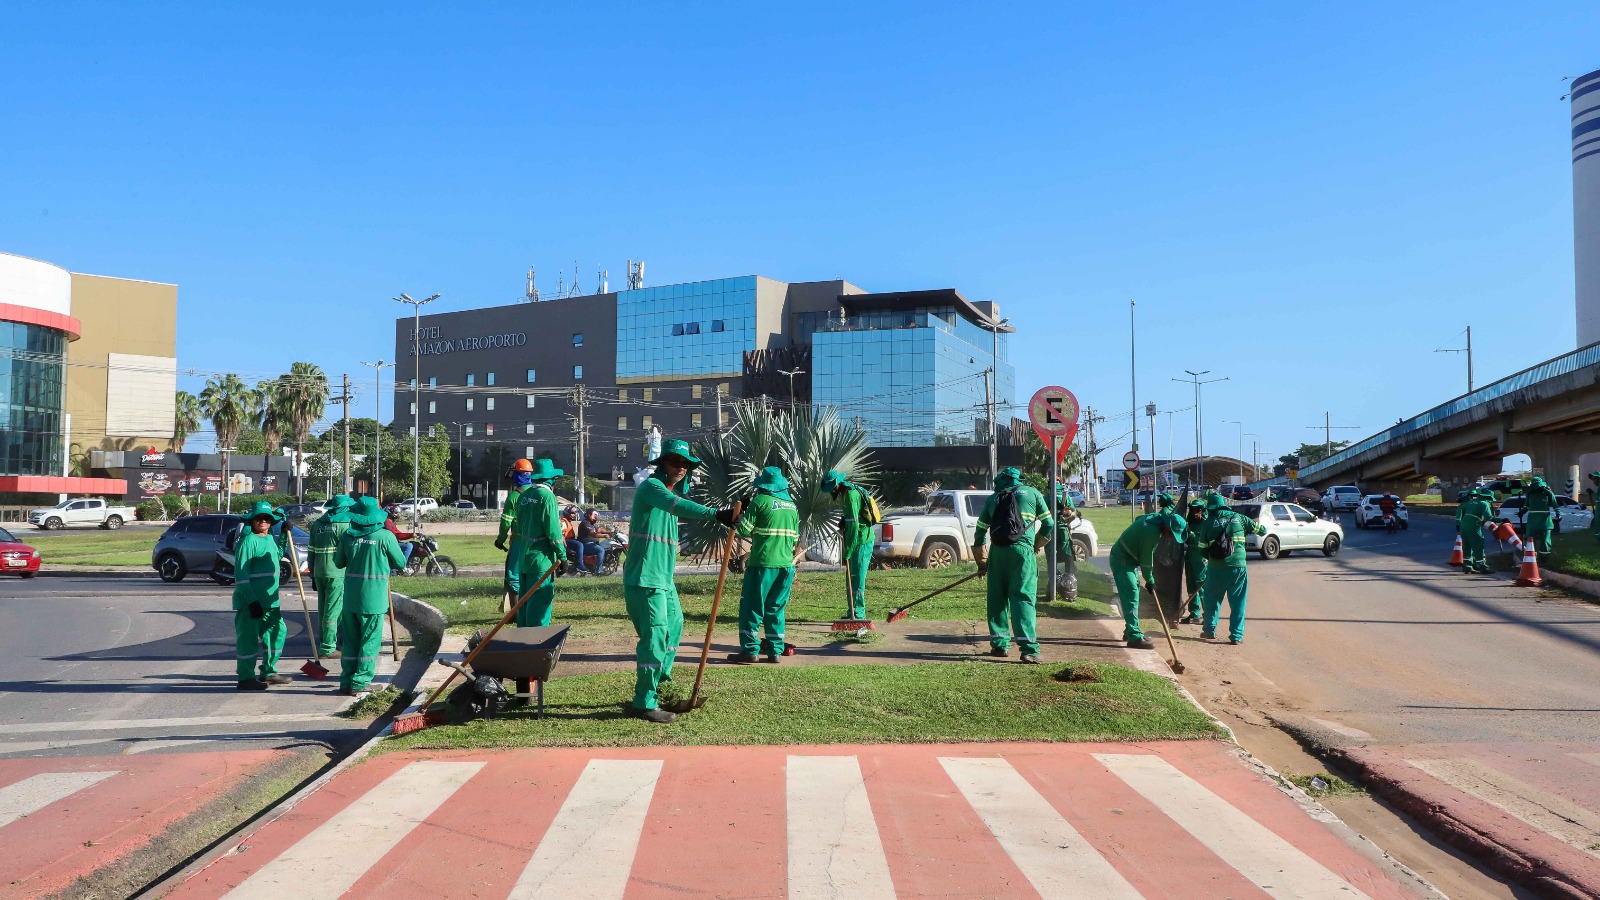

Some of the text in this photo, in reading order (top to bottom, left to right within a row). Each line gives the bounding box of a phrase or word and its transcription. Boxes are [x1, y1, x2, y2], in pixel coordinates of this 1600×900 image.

[409, 332, 526, 356] AMAZON AEROPORTO
[410, 326, 443, 340] HOTEL
[1046, 397, 1062, 423] E
